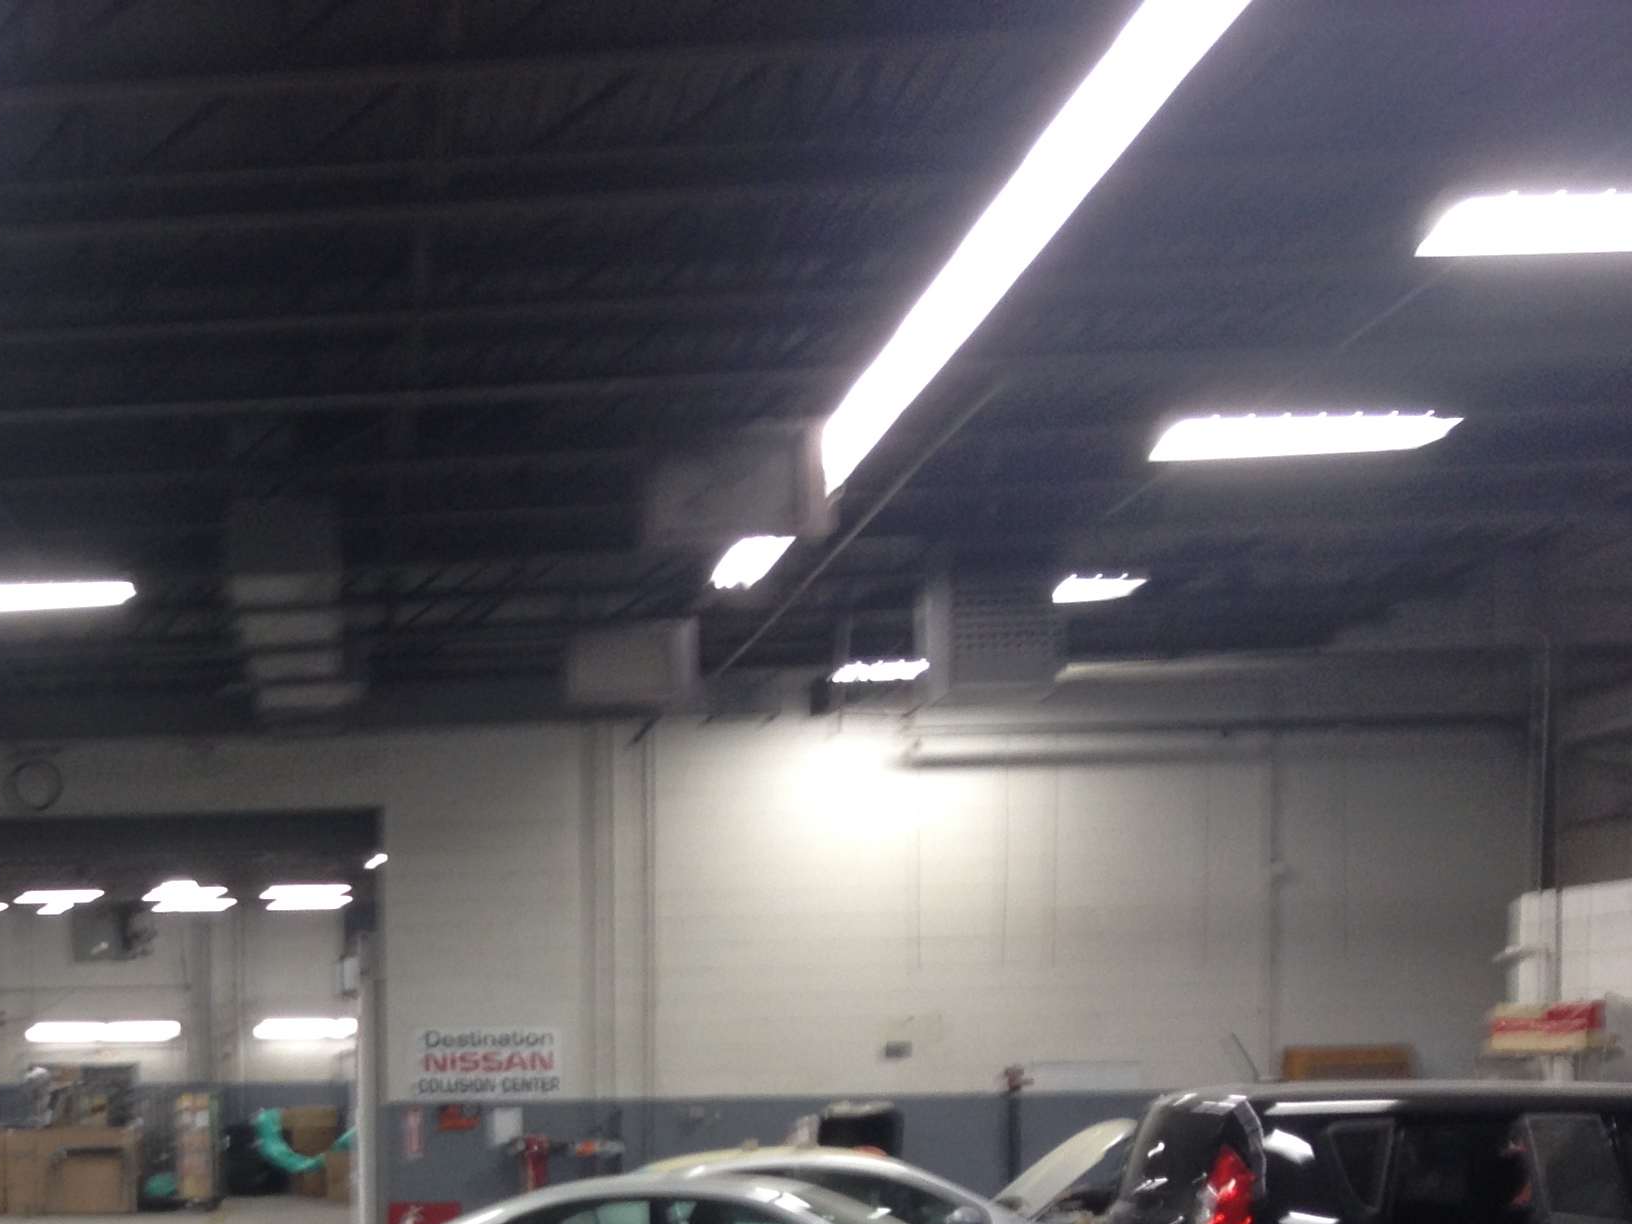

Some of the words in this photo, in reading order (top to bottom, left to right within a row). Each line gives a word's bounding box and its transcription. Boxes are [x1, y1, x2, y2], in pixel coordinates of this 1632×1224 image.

[424, 1029, 555, 1048] Destination
[423, 1051, 555, 1072] NISSAN
[418, 1076, 496, 1094] COLLISION
[502, 1076, 561, 1092] CENTER
